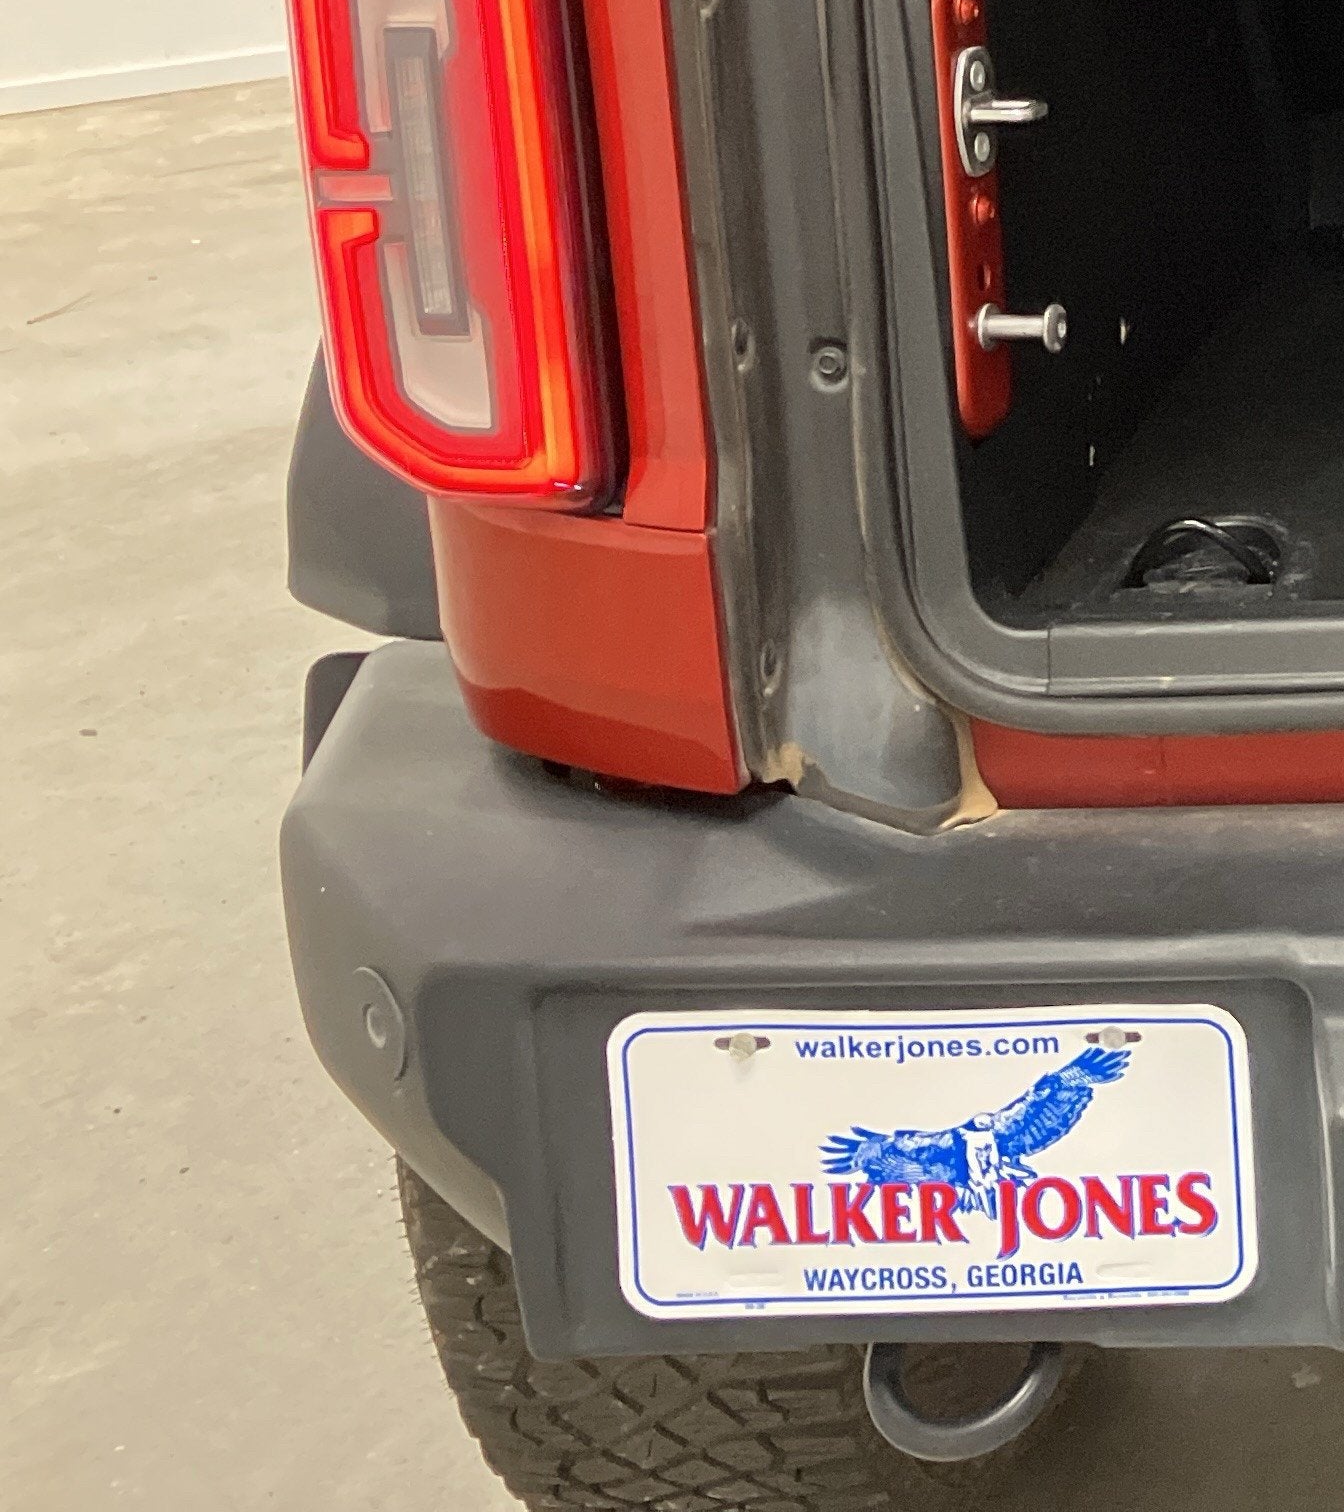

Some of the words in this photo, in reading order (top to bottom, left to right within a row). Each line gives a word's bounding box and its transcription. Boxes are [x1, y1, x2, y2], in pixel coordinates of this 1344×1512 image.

[795, 1034, 1059, 1063] walkerjones.com
[667, 1182, 970, 1250] WALKER
[998, 1172, 1219, 1259] JONES
[803, 1265, 957, 1292] WAYCROSS,
[967, 1262, 1084, 1289] GEORGIA
